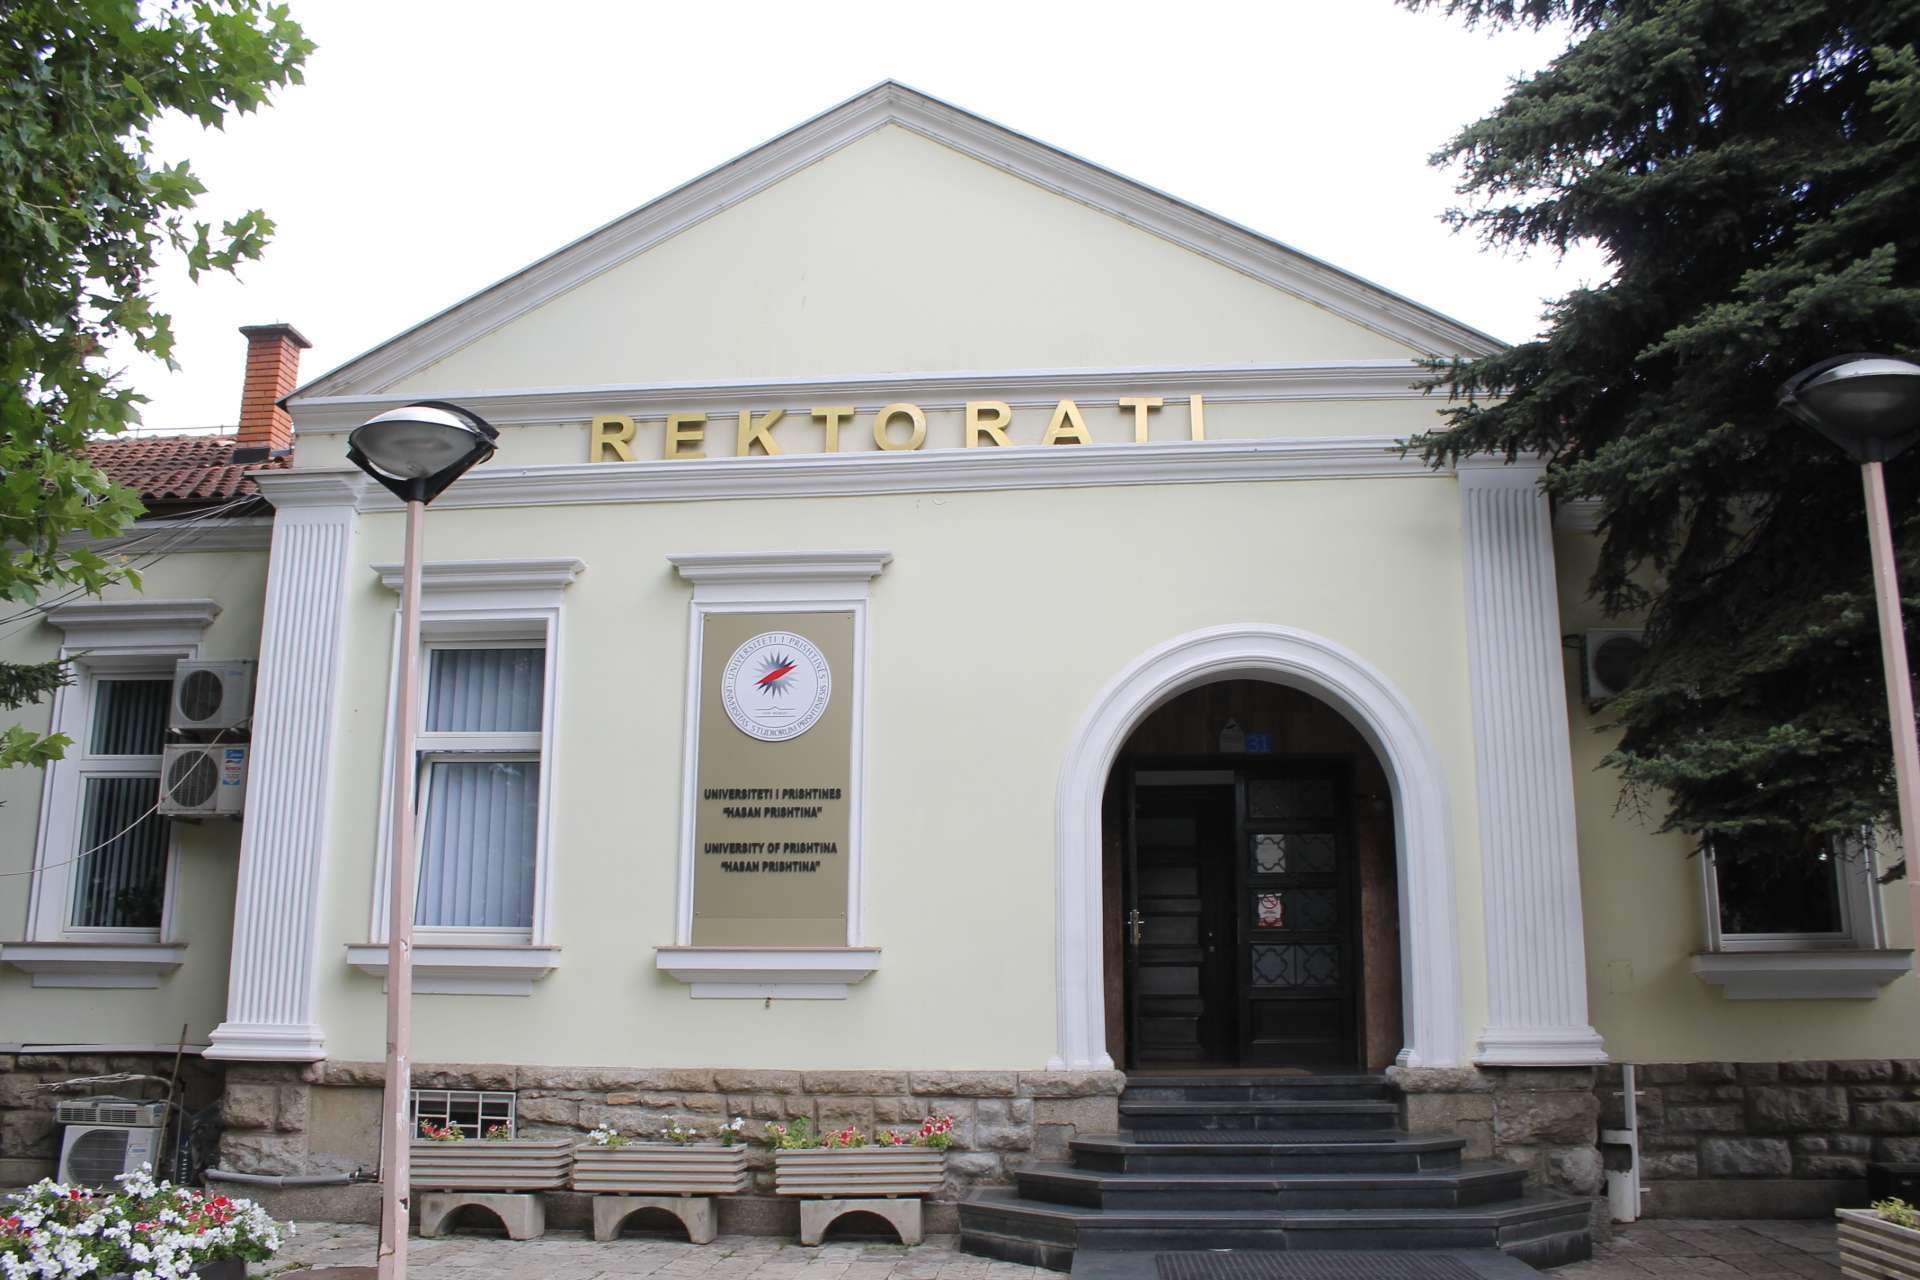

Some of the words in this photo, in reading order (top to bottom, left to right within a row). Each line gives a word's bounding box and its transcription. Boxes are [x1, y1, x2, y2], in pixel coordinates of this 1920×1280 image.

[588, 394, 1205, 463] REKTORATI
[704, 788, 773, 800] UNIVERSITETI
[775, 788, 779, 800] I
[704, 843, 765, 854] UNIVERSITY
[767, 843, 781, 854] OF
[783, 843, 837, 854] PRISHTINA
